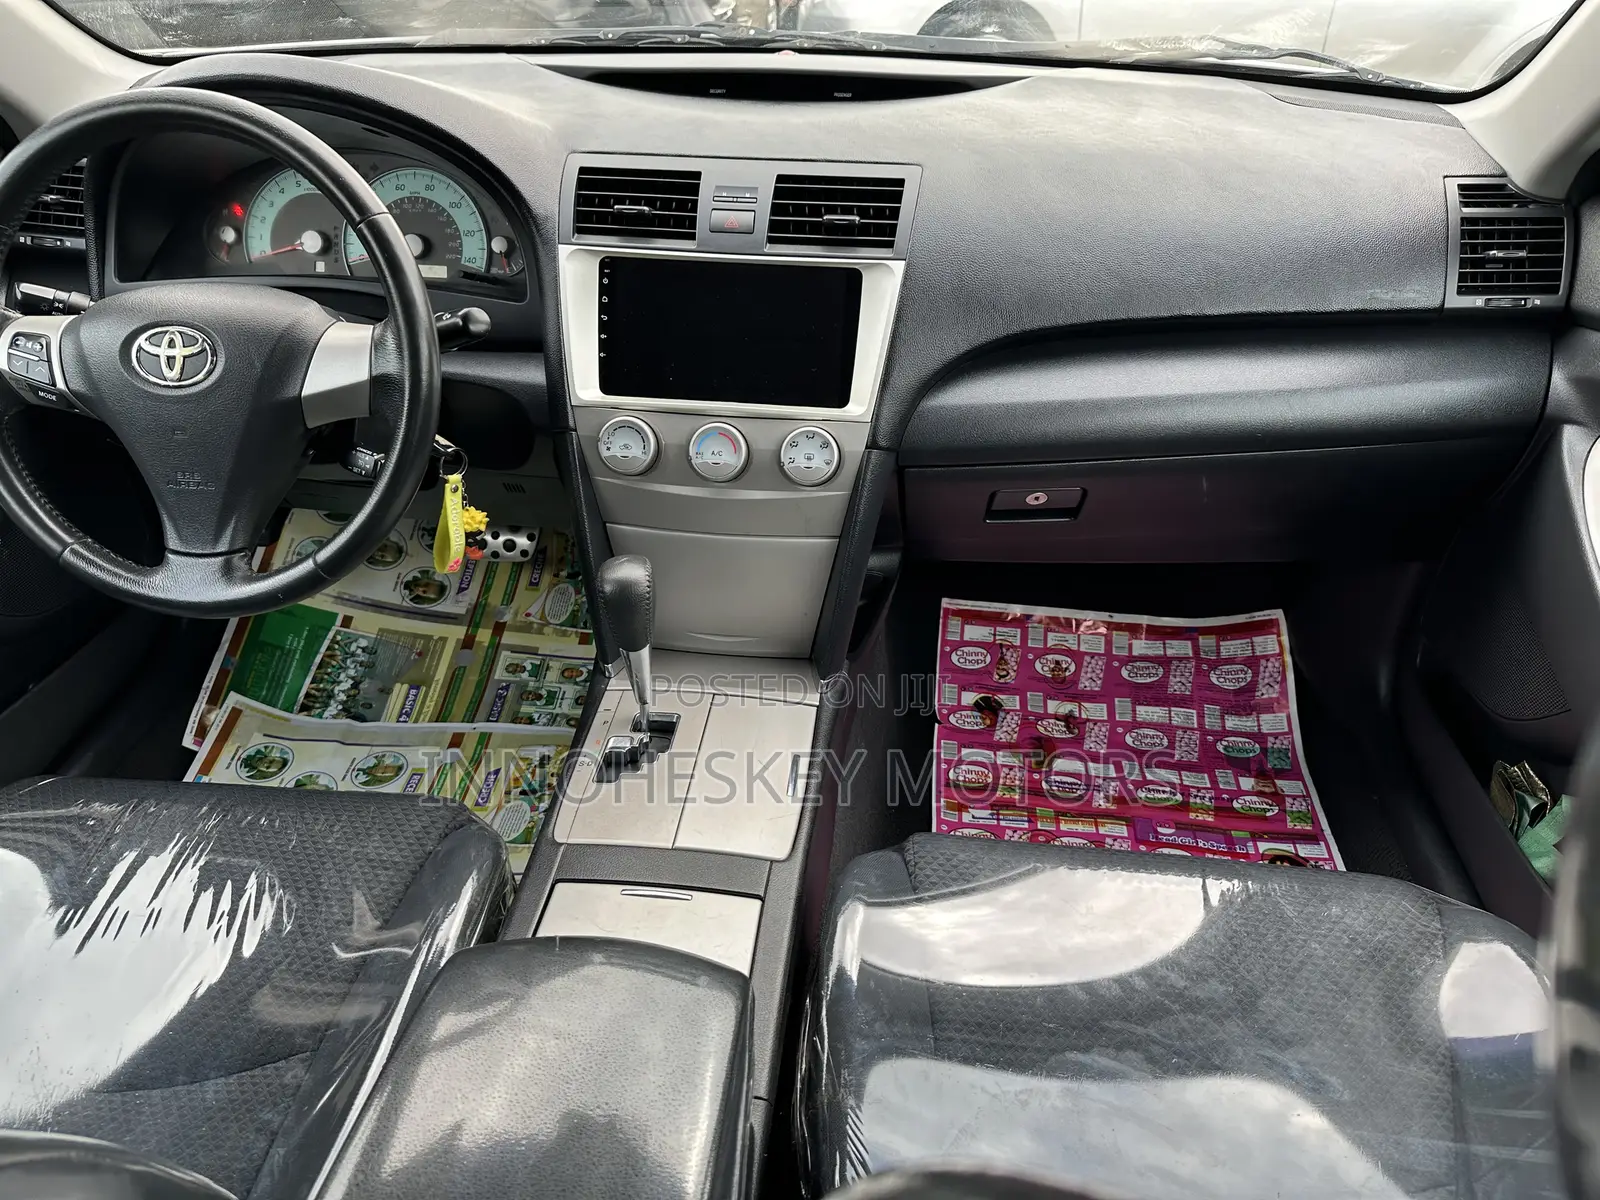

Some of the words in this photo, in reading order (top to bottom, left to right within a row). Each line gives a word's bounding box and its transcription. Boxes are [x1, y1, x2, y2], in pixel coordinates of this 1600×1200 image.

[295, 180, 302, 188] 5
[395, 183, 406, 192] 60
[424, 183, 436, 192] 80
[278, 187, 285, 195] 4
[268, 200, 275, 208] 3
[448, 201, 462, 209] 100
[260, 216, 267, 224] 2
[462, 229, 476, 238] 120
[463, 256, 477, 265] 140
[38, 391, 57, 401] MODE
[450, 498, 462, 553] Adorable
[955, 649, 989, 660] Chinny
[957, 656, 988, 666] Chops
[1216, 675, 1248, 685] Chops
[404, 688, 419, 714] BASIC
[478, 774, 497, 804] CRECHE
